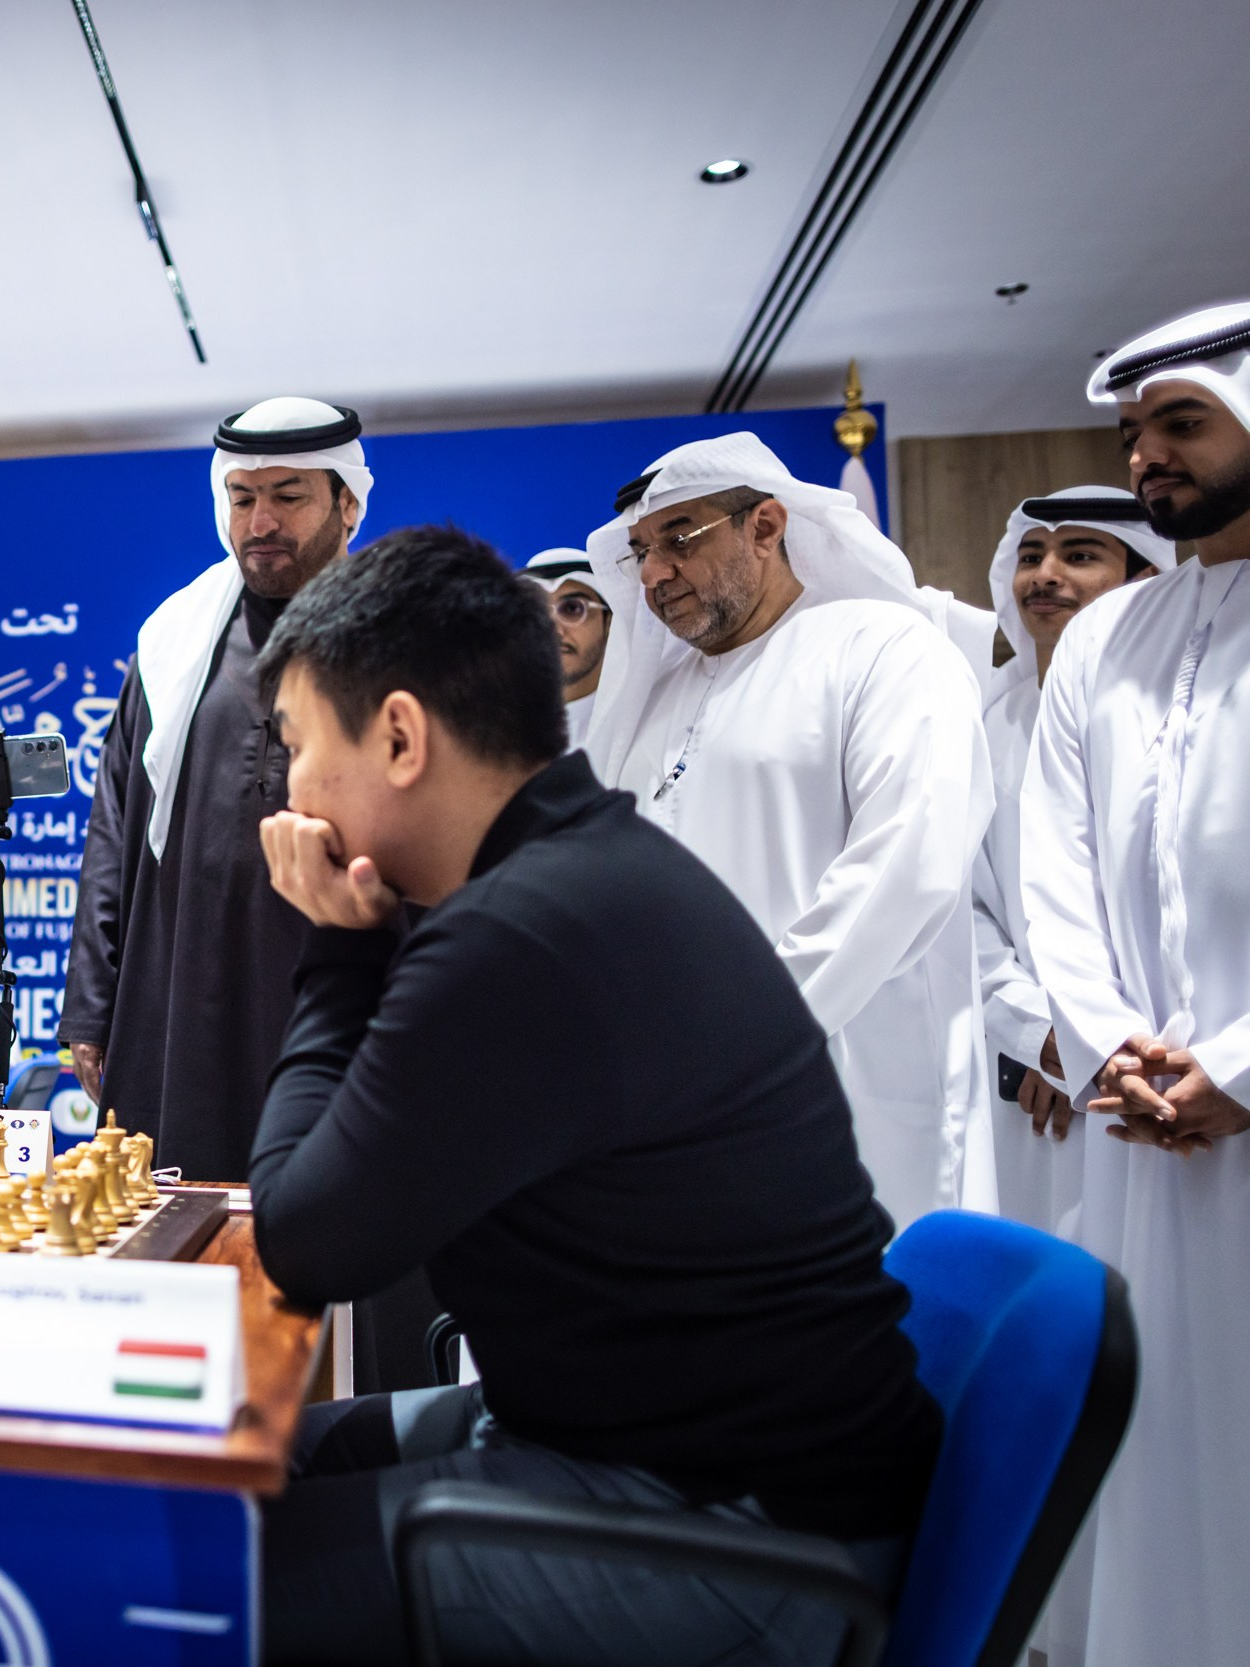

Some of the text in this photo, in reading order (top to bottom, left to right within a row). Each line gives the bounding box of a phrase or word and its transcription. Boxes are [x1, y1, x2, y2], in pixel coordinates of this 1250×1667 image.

[0, 603, 79, 637] تحت
[21, 811, 77, 846] إمارة
[18, 1146, 31, 1163] 3
